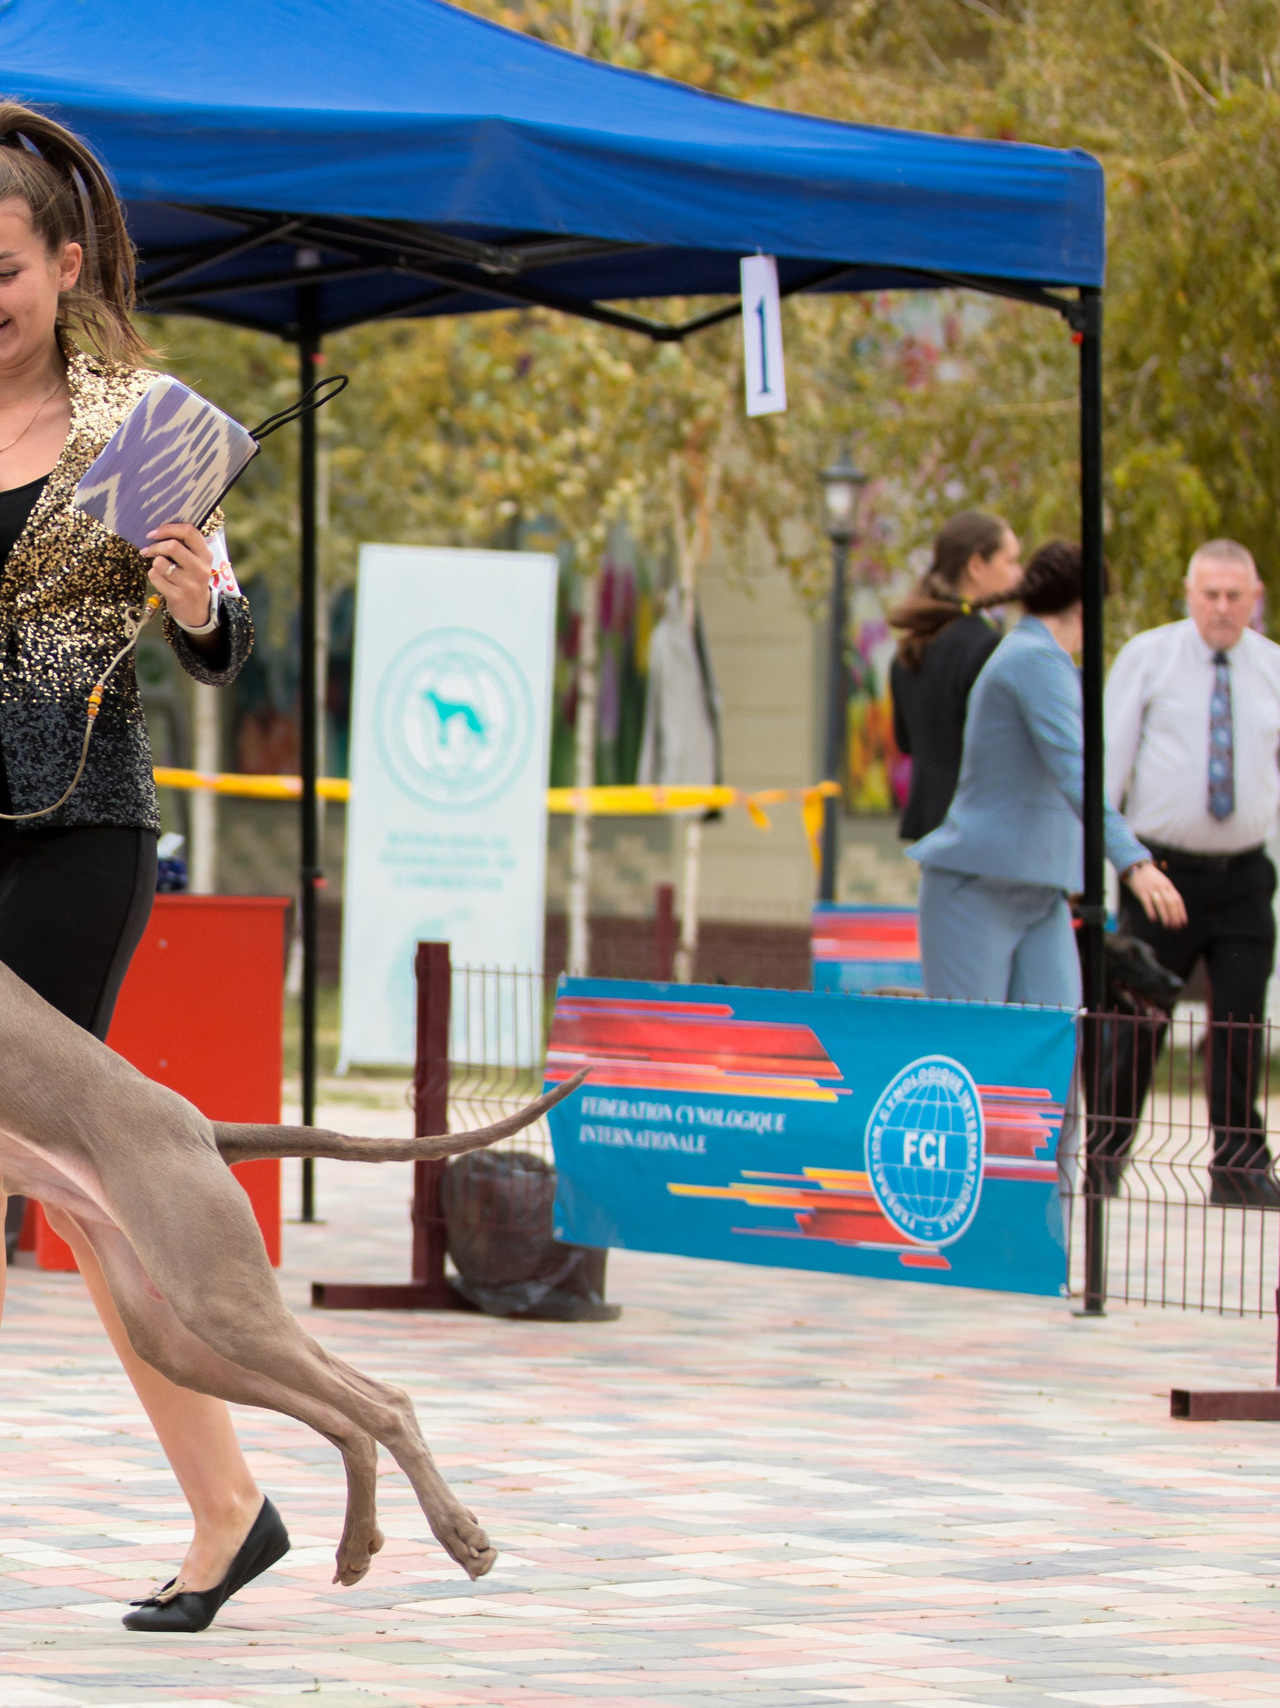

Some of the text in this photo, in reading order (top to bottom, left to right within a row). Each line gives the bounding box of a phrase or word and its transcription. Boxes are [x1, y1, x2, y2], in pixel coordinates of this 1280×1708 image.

[754, 295, 773, 395] 1
[581, 1095, 787, 1135] FEDERATION CYNOLOGIQUE
[579, 1123, 707, 1155] INTERNATIONALE
[902, 1131, 947, 1170] FCI
